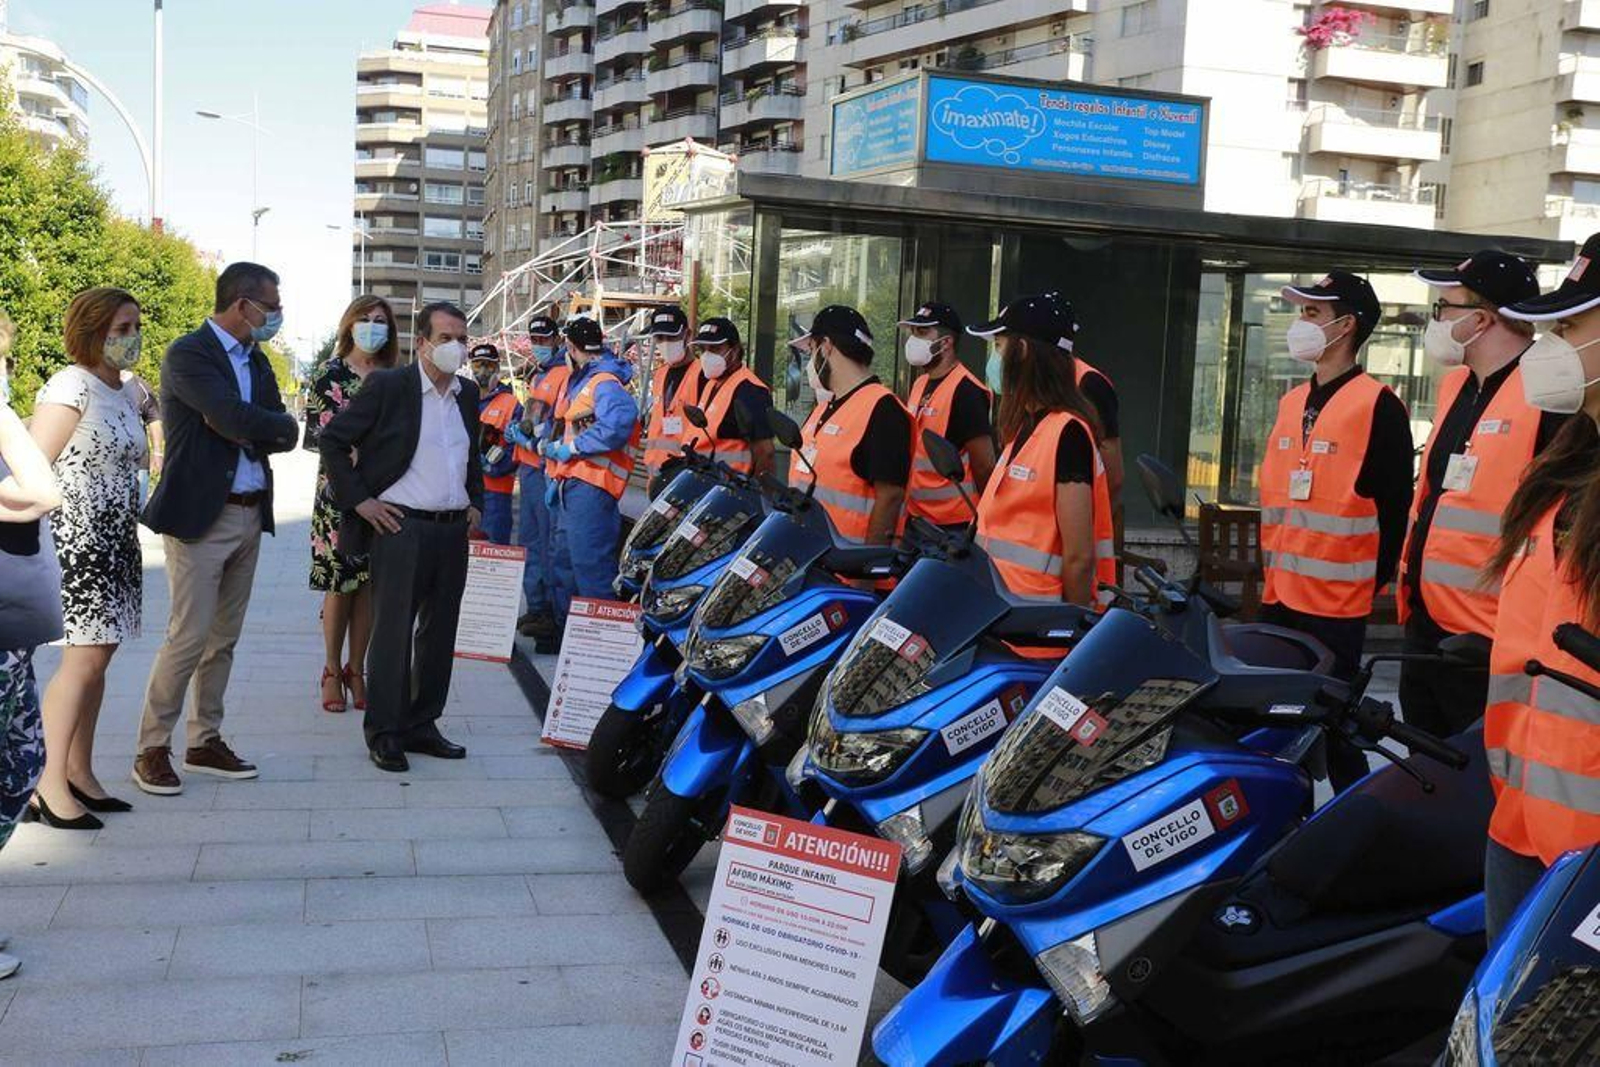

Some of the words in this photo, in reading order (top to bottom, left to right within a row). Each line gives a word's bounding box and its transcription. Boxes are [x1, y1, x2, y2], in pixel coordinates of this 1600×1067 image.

[1039, 92, 1071, 110] Tenda
[1074, 99, 1109, 115] regalos
[1112, 101, 1147, 117] Infantil
[941, 103, 1038, 133] imaxinate!
[1088, 120, 1120, 131] Escolar
[1053, 130, 1081, 142] Xogos
[1082, 132, 1127, 145] Educativos
[1143, 138, 1171, 151] Disney
[784, 619, 822, 644] CONCELLO
[947, 706, 998, 740] CONCELLO
[956, 735, 970, 746] DE
[972, 719, 996, 736] VIGO
[1131, 810, 1201, 851] CONCELLO
[1144, 843, 1163, 858] DE
[1166, 825, 1198, 847] VIGO
[783, 830, 890, 872] ATENCIÓN!!!
[730, 867, 758, 881] AFORO
[768, 859, 800, 874] PARQUE
[750, 922, 760, 931] DE
[761, 925, 777, 936] USO
[735, 938, 748, 947] USO
